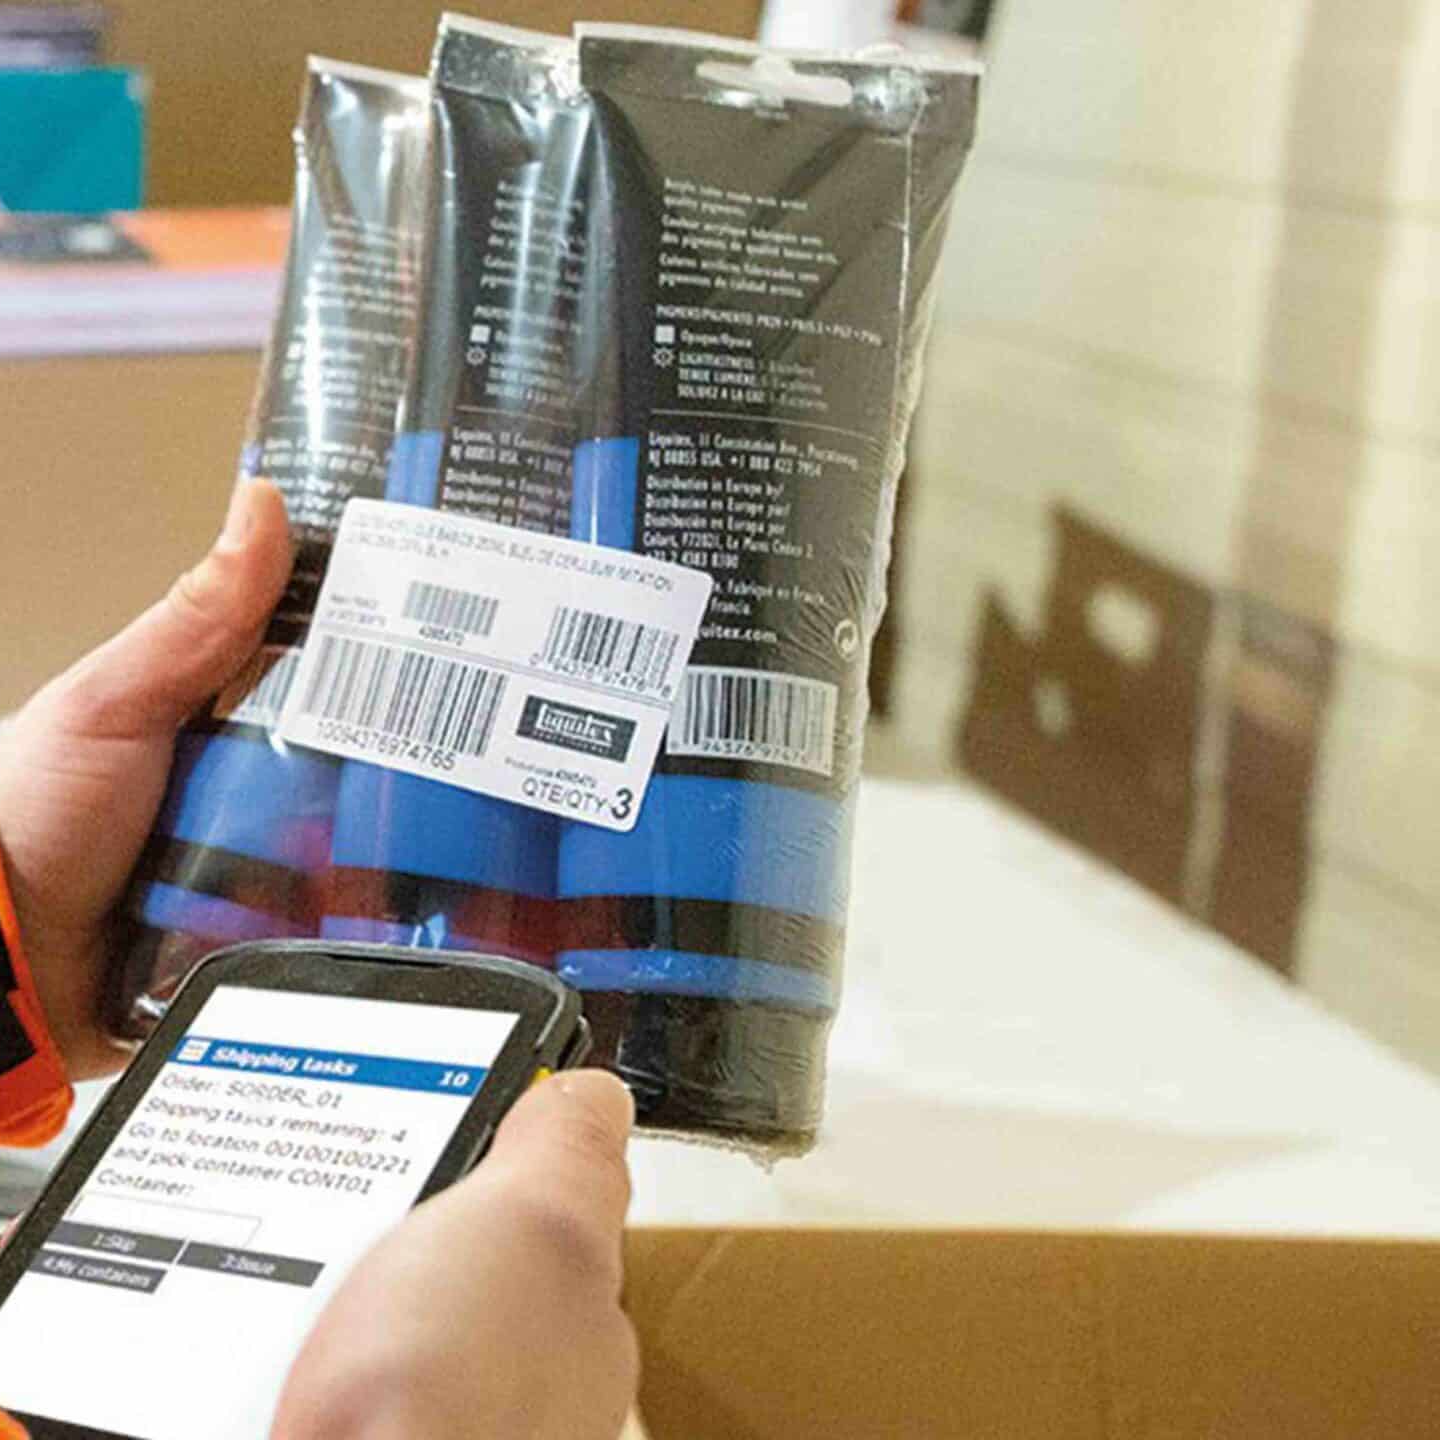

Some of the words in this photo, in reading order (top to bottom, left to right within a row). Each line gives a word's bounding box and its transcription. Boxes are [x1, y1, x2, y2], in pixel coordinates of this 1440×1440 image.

[520, 775, 609, 815] QTE/QTY
[610, 786, 635, 821] 3
[210, 1046, 300, 1073] Shipping
[300, 1055, 360, 1078] tasks
[438, 1070, 471, 1088] 10
[161, 1071, 221, 1094] Order:
[225, 1078, 344, 1110] SORDER_01
[143, 1096, 222, 1124] Shipping
[224, 1106, 277, 1129] tasks
[280, 1115, 388, 1146] remaining:
[390, 1128, 409, 1144] 4
[112, 1145, 152, 1163] and
[147, 1149, 191, 1172] pick
[191, 1155, 285, 1182] container
[286, 1165, 374, 1196] CONT01
[127, 1120, 157, 1139] Go
[160, 1124, 182, 1144] to
[185, 1127, 261, 1153] location
[264, 1138, 413, 1177] 00100100221
[96, 1167, 196, 1197] Container:
